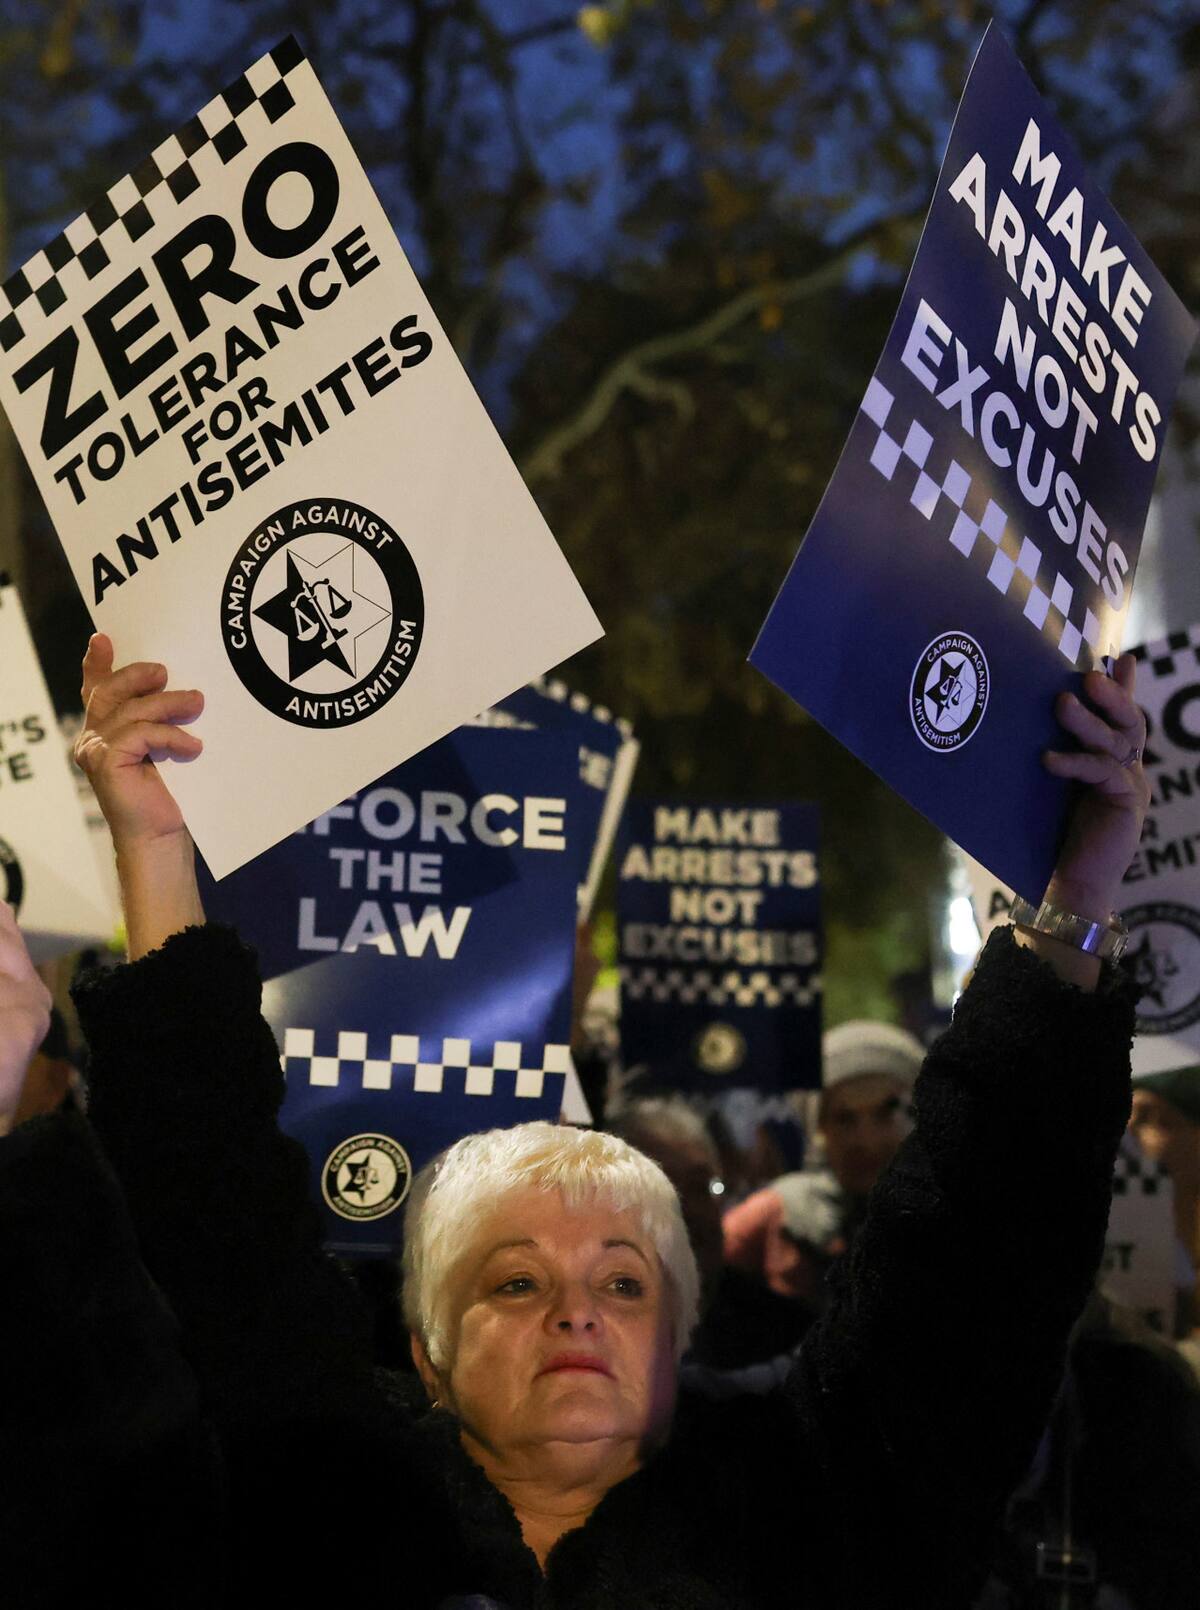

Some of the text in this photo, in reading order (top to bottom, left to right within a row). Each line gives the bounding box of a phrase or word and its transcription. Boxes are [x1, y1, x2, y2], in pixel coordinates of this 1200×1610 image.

[1012, 117, 1153, 349] MAKE
[11, 141, 340, 461] ZERO
[948, 152, 1162, 463] ARRESTS
[54, 224, 381, 505] TOLERANCE
[994, 296, 1099, 466] NOT
[92, 314, 434, 607] ANTISEMITES
[181, 376, 277, 465] FOR
[901, 298, 1130, 612] EXCUSES
[227, 505, 394, 649] CAMPAIGN AGAINST
[285, 619, 417, 721] ANTISEMITISM
[927, 638, 986, 709] CAMPAIGN AGAINST
[914, 697, 961, 746] ANTISEMITISM
[296, 787, 566, 851] FORCE
[620, 844, 819, 889] ARRESTS
[653, 806, 781, 847] MAKE
[329, 847, 443, 894] THE
[669, 885, 763, 926] NOT
[298, 897, 472, 959] LAW
